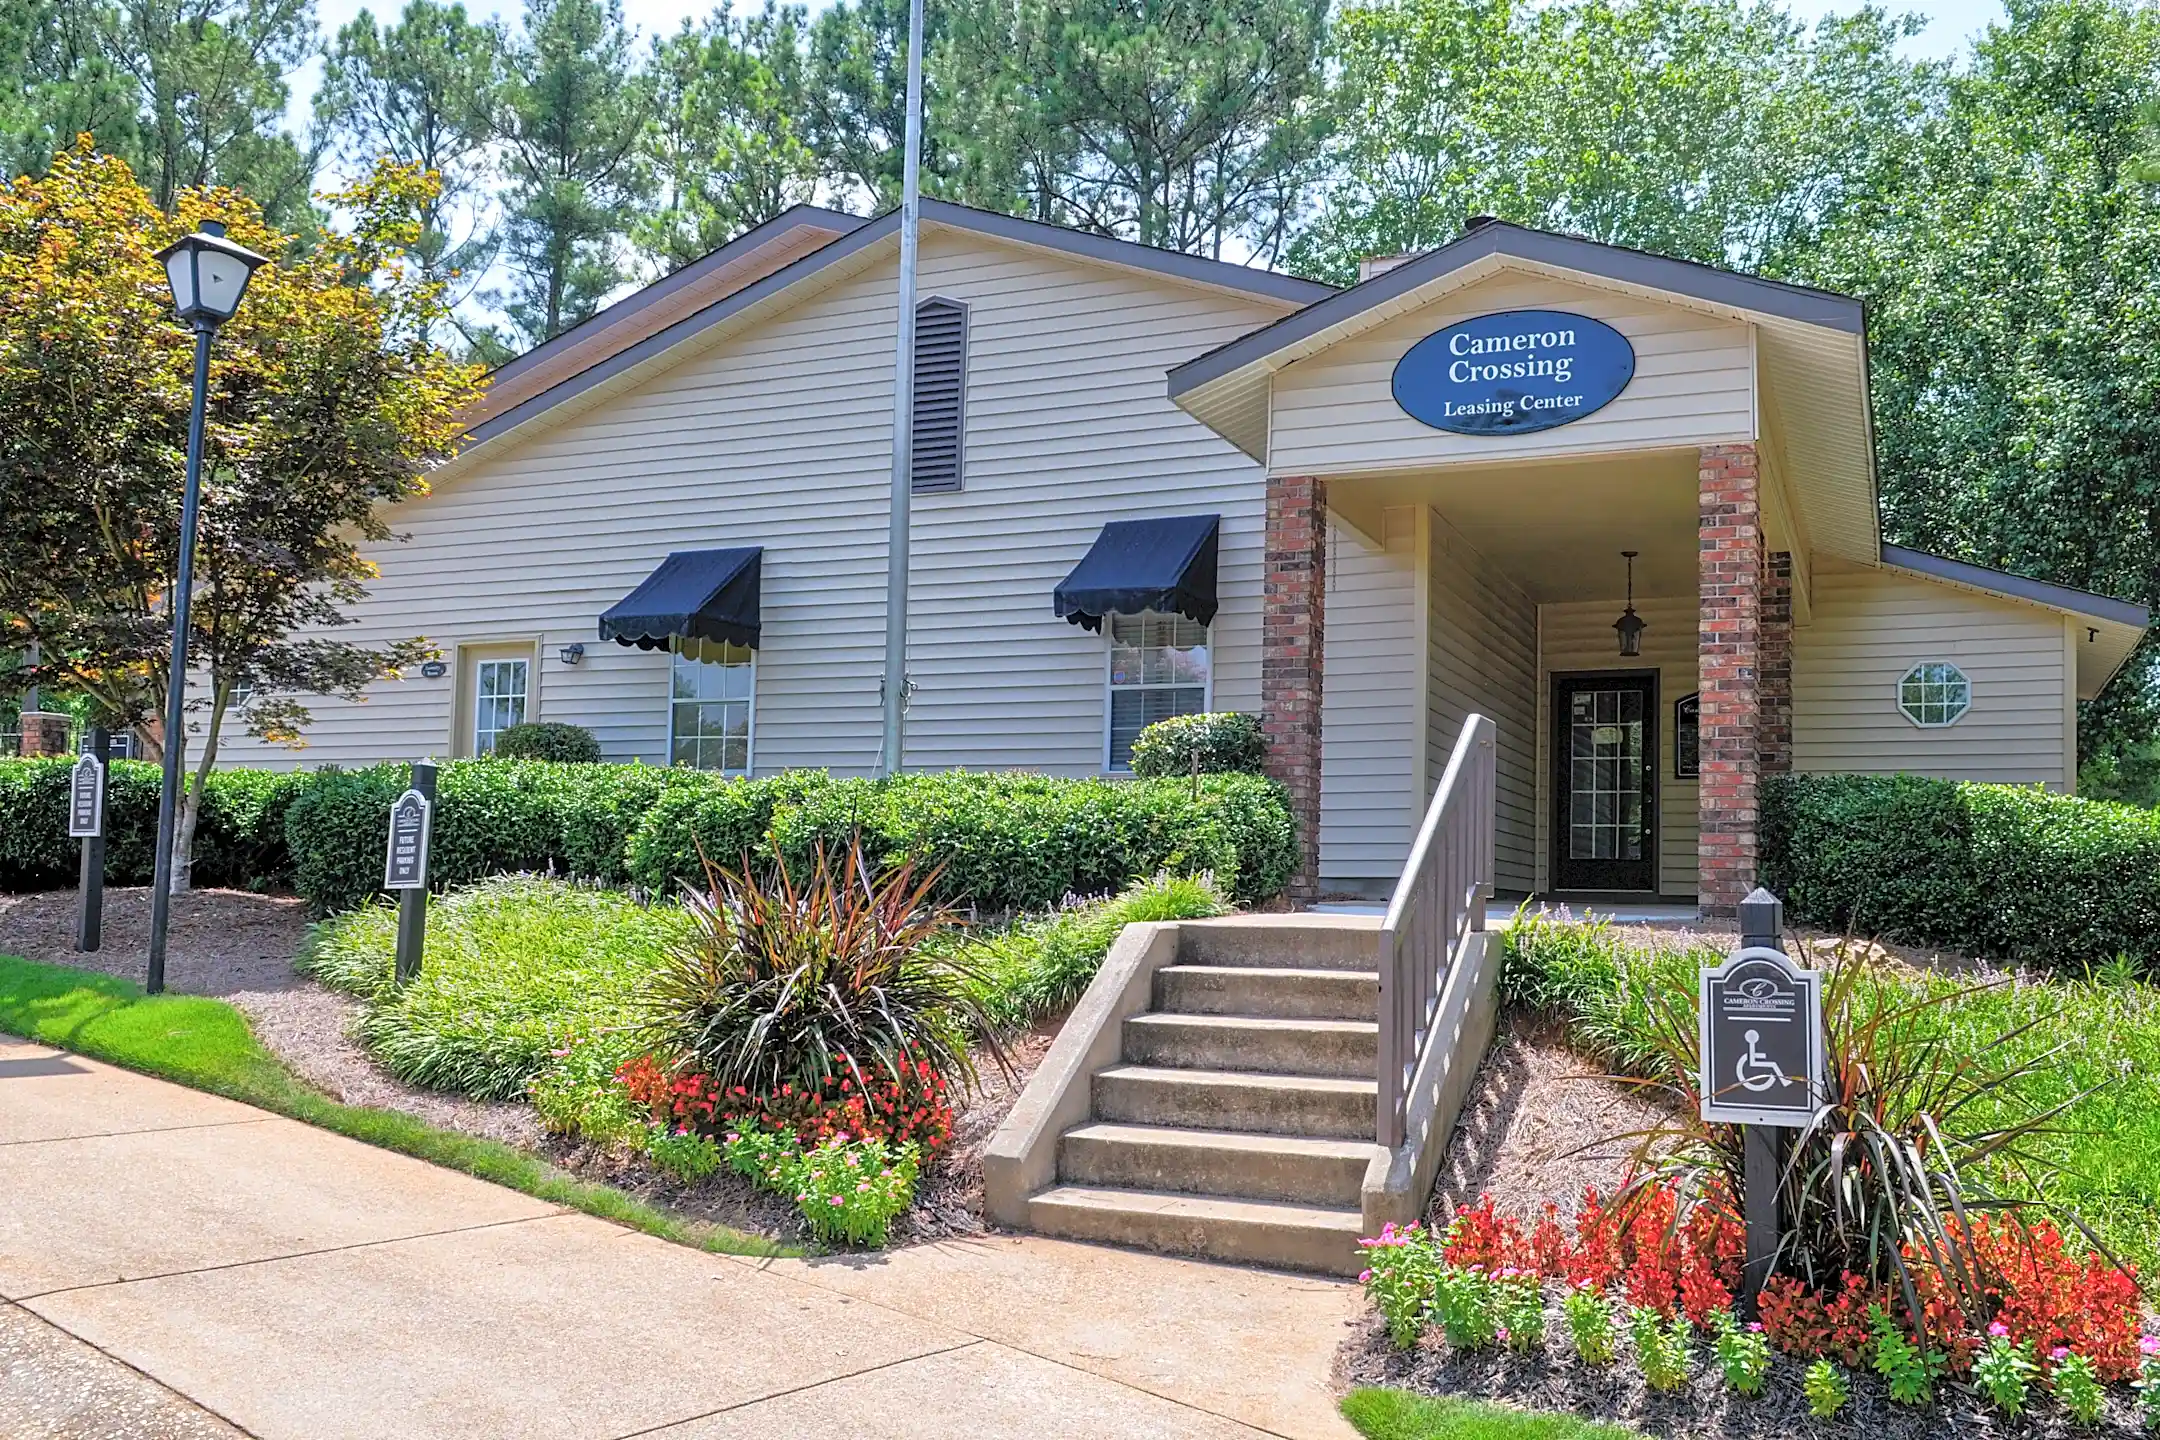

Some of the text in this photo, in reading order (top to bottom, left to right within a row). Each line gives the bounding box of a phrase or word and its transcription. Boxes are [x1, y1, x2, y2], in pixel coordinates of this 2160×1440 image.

[1449, 329, 1576, 356] Cameron
[1449, 354, 1574, 383] Crossing
[1444, 394, 1583, 417] Leasing Center
[399, 836, 414, 844] FUTURE
[396, 845, 416, 854] RESIDENT
[399, 867, 410, 875] ONLY
